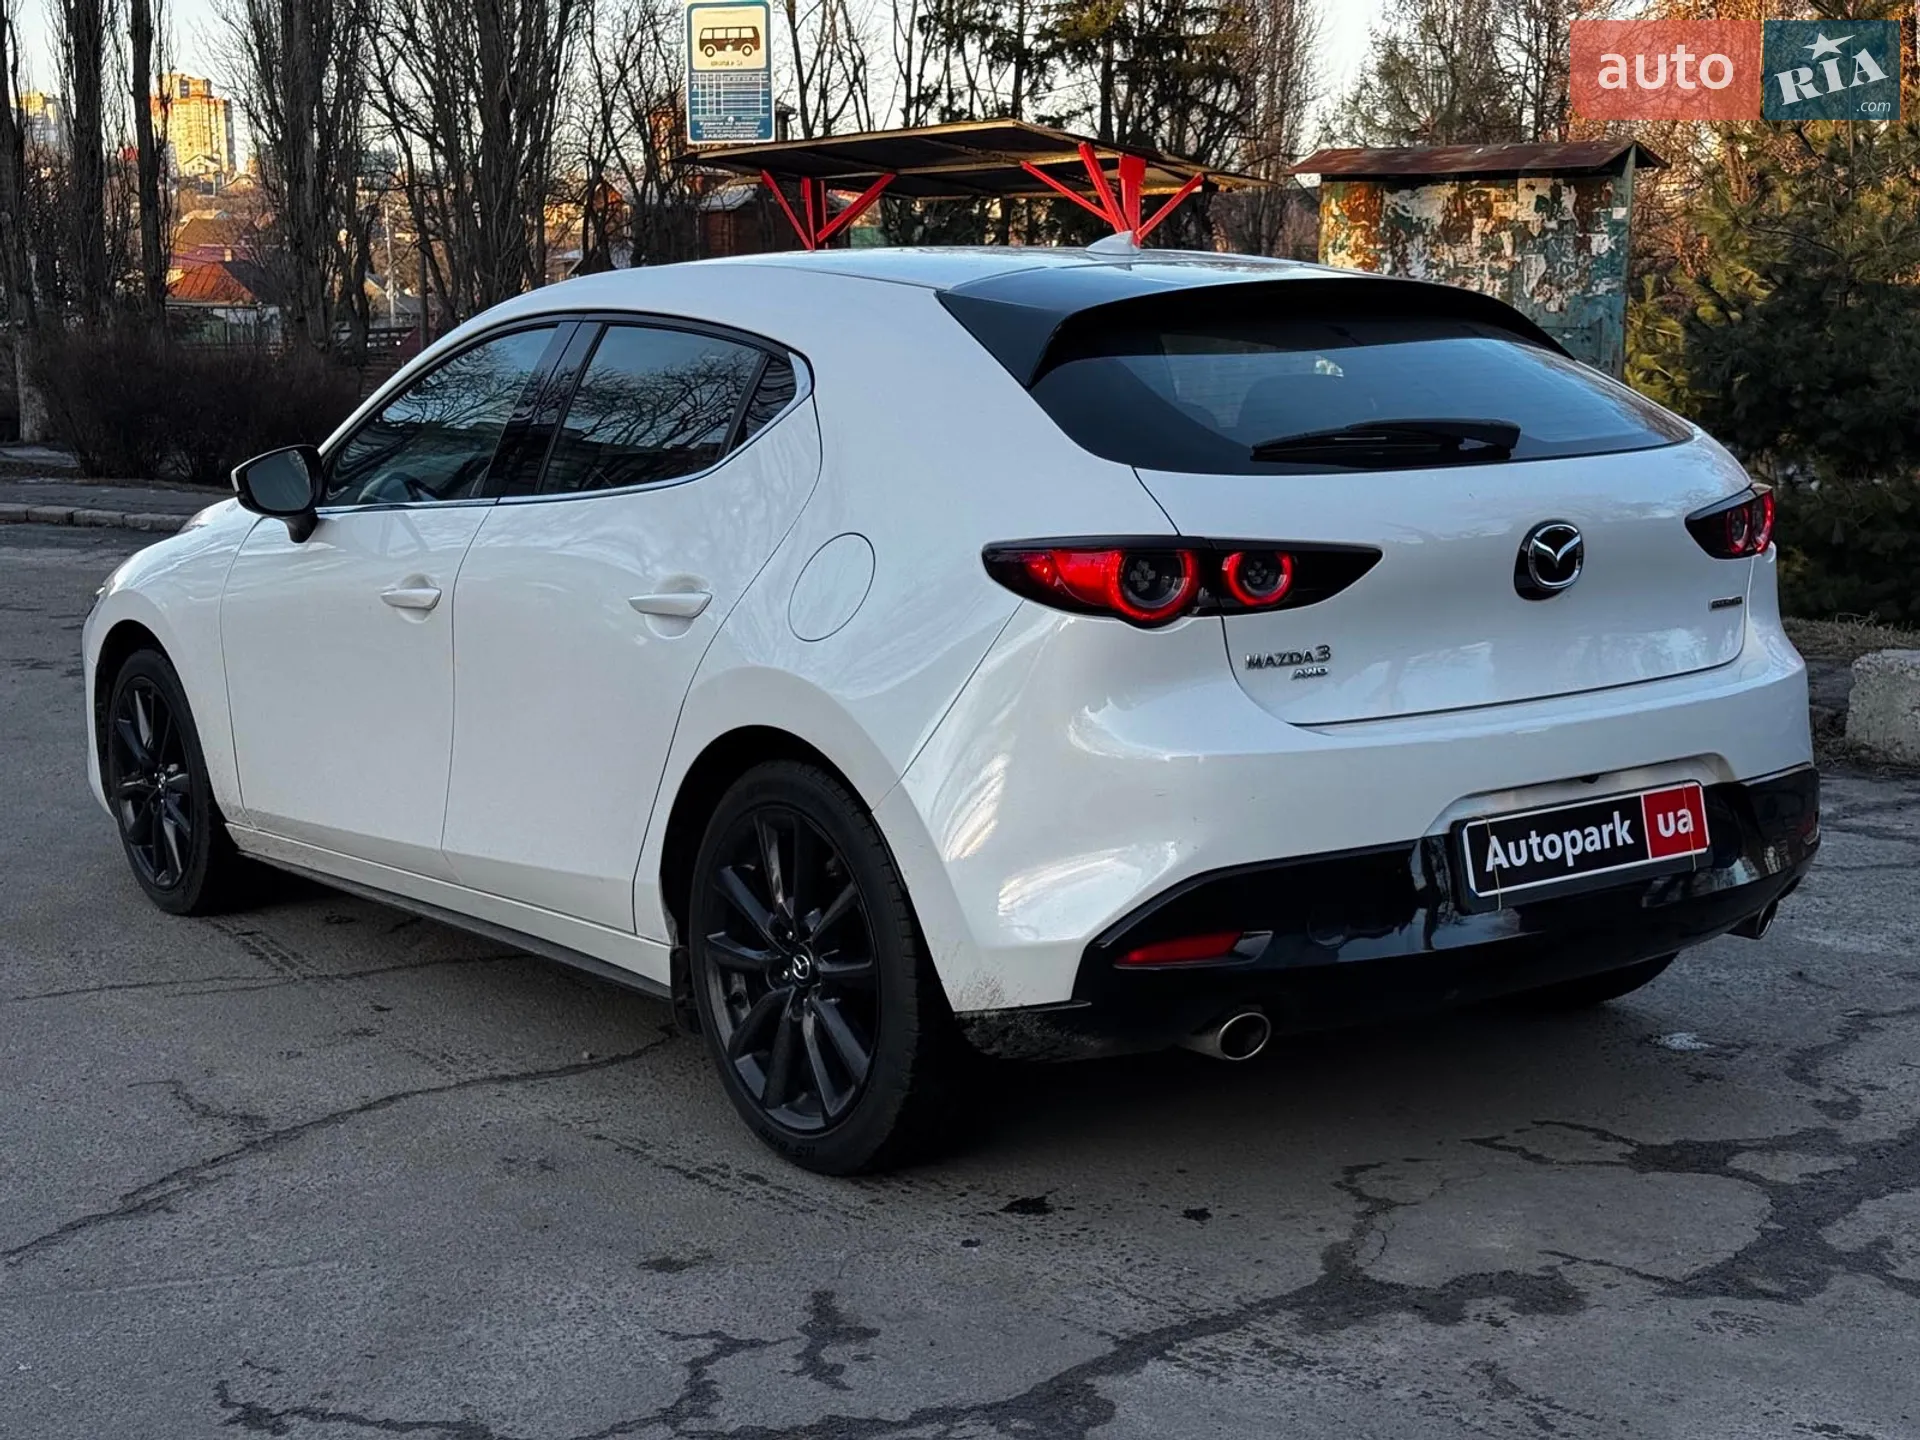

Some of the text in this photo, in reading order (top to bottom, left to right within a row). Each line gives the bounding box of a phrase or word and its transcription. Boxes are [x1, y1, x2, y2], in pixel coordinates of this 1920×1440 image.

[1290, 666, 1329, 680] AWD
[1485, 809, 1694, 873] Autopark ua
